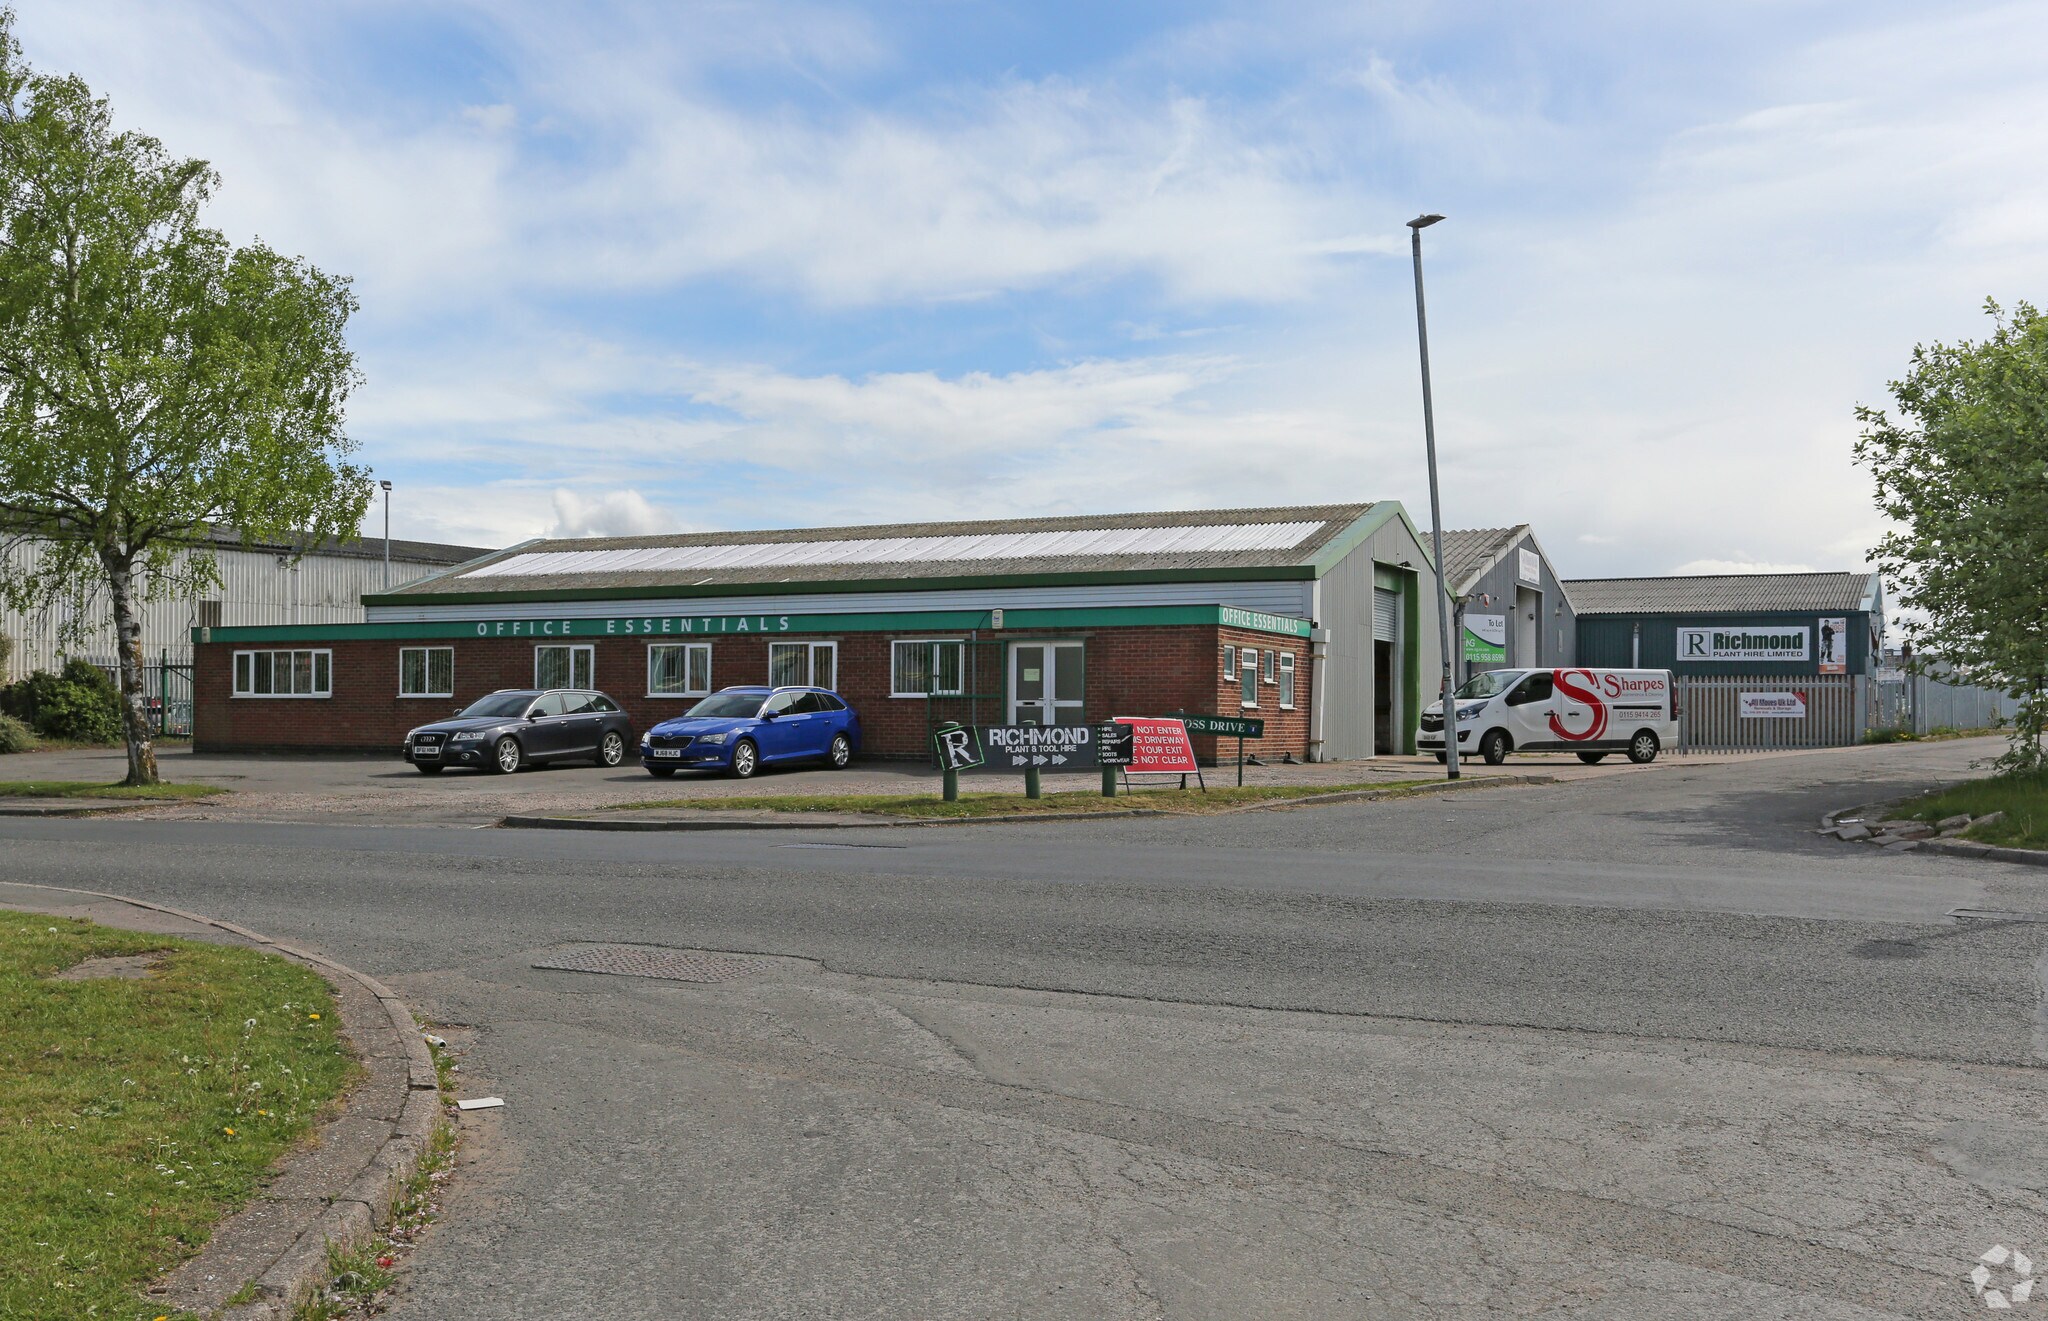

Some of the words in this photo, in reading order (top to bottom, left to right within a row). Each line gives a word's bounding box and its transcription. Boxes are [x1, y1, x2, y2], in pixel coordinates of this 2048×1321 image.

[477, 621, 571, 636] OFFICE
[606, 616, 789, 633] ESSENTIALS
[1223, 608, 1251, 627] OFFICE
[1253, 613, 1298, 633] ESSENTIALS
[1488, 619, 1495, 627] To
[1687, 633, 1707, 655] R
[1713, 631, 1804, 650] Richmond
[1466, 653, 1480, 661] 0115
[1604, 674, 1665, 698] Sharpes
[1136, 726, 1154, 734] NOT
[1157, 726, 1183, 735] ENTER
[1184, 719, 1206, 730] OSS
[1210, 720, 1245, 733] DRIVE
[989, 727, 1089, 746] RICHMOND
[1133, 736, 1142, 744] IS
[1144, 736, 1184, 744] DRIVEWAY
[941, 730, 979, 769] R
[1005, 745, 1029, 753] PLANT
[1060, 744, 1077, 752] HIRE
[1140, 745, 1163, 754] YOUR
[1165, 746, 1183, 754] EXIT
[1141, 756, 1158, 764] NOT
[1161, 756, 1188, 764] CLEAR
